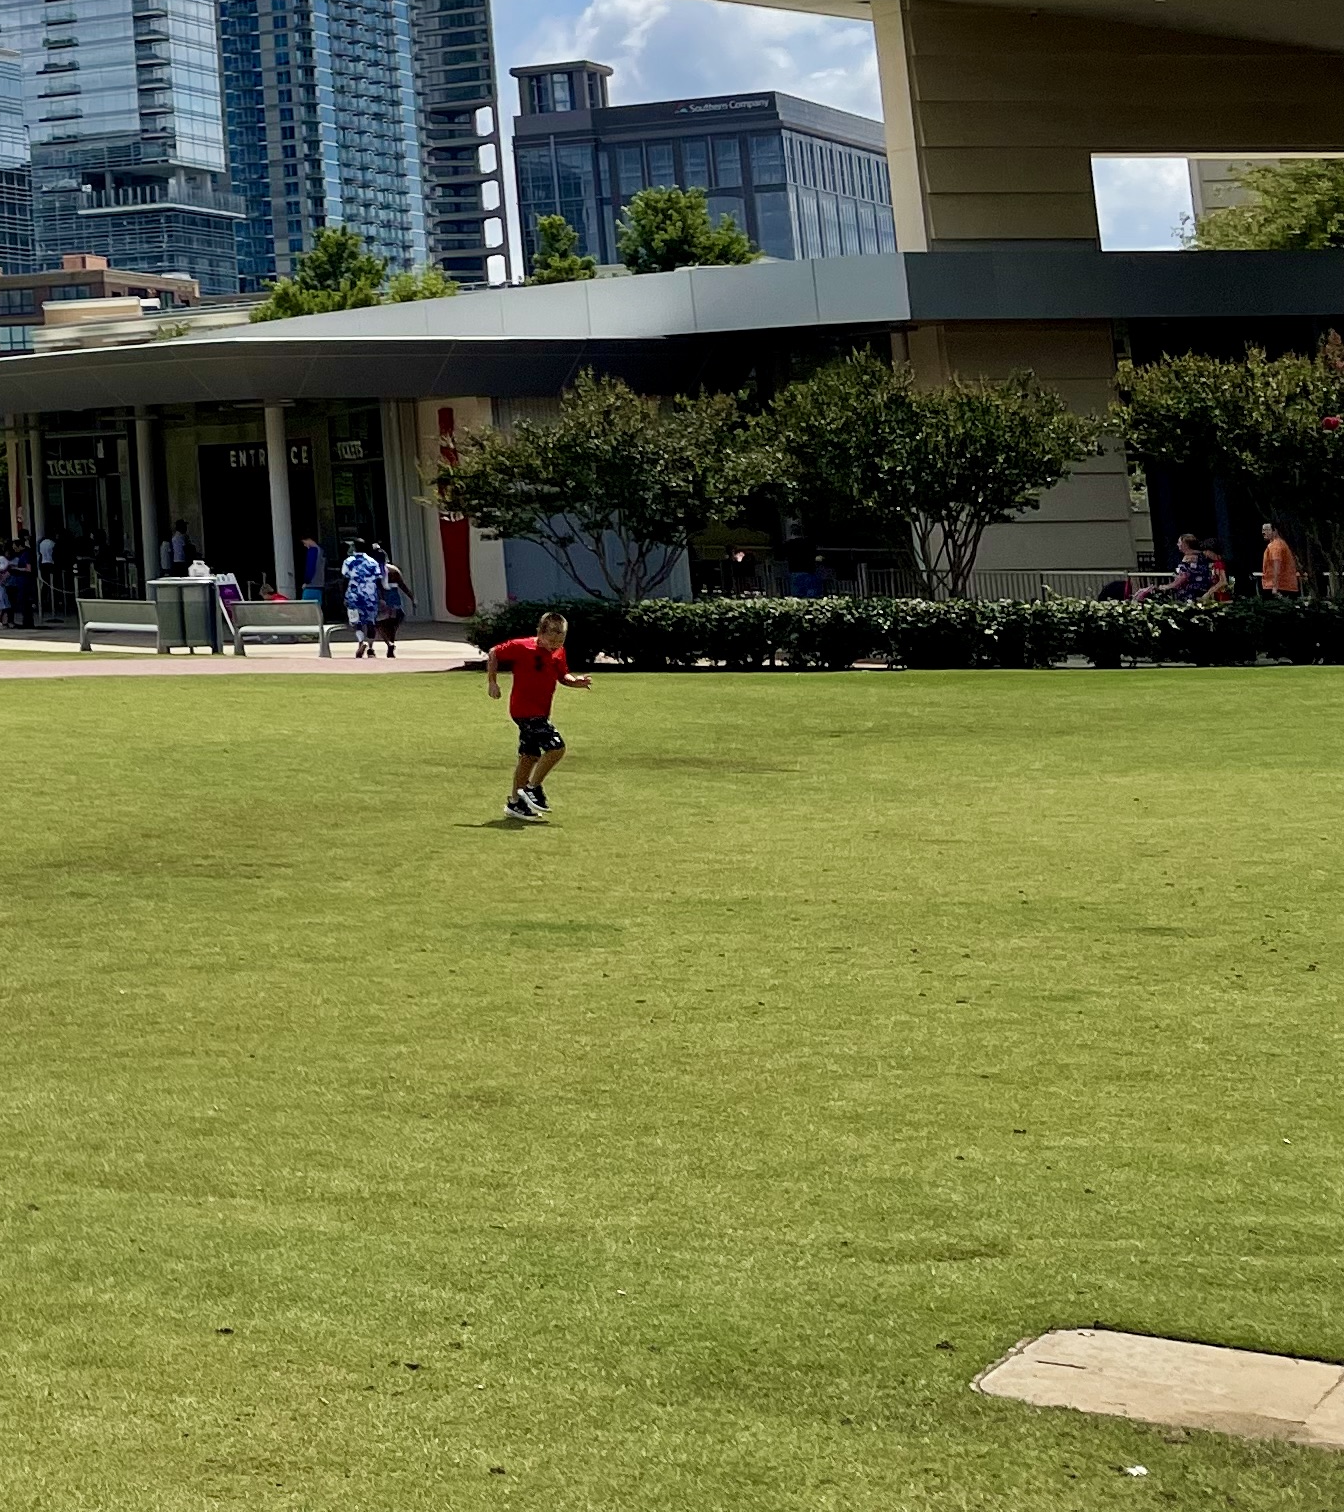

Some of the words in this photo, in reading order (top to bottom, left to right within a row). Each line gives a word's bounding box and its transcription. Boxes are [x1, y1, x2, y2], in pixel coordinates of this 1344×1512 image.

[689, 101, 728, 113] Southern
[729, 99, 770, 109] Company
[229, 445, 309, 468] ENTRCE
[46, 459, 96, 476] TICKETS
